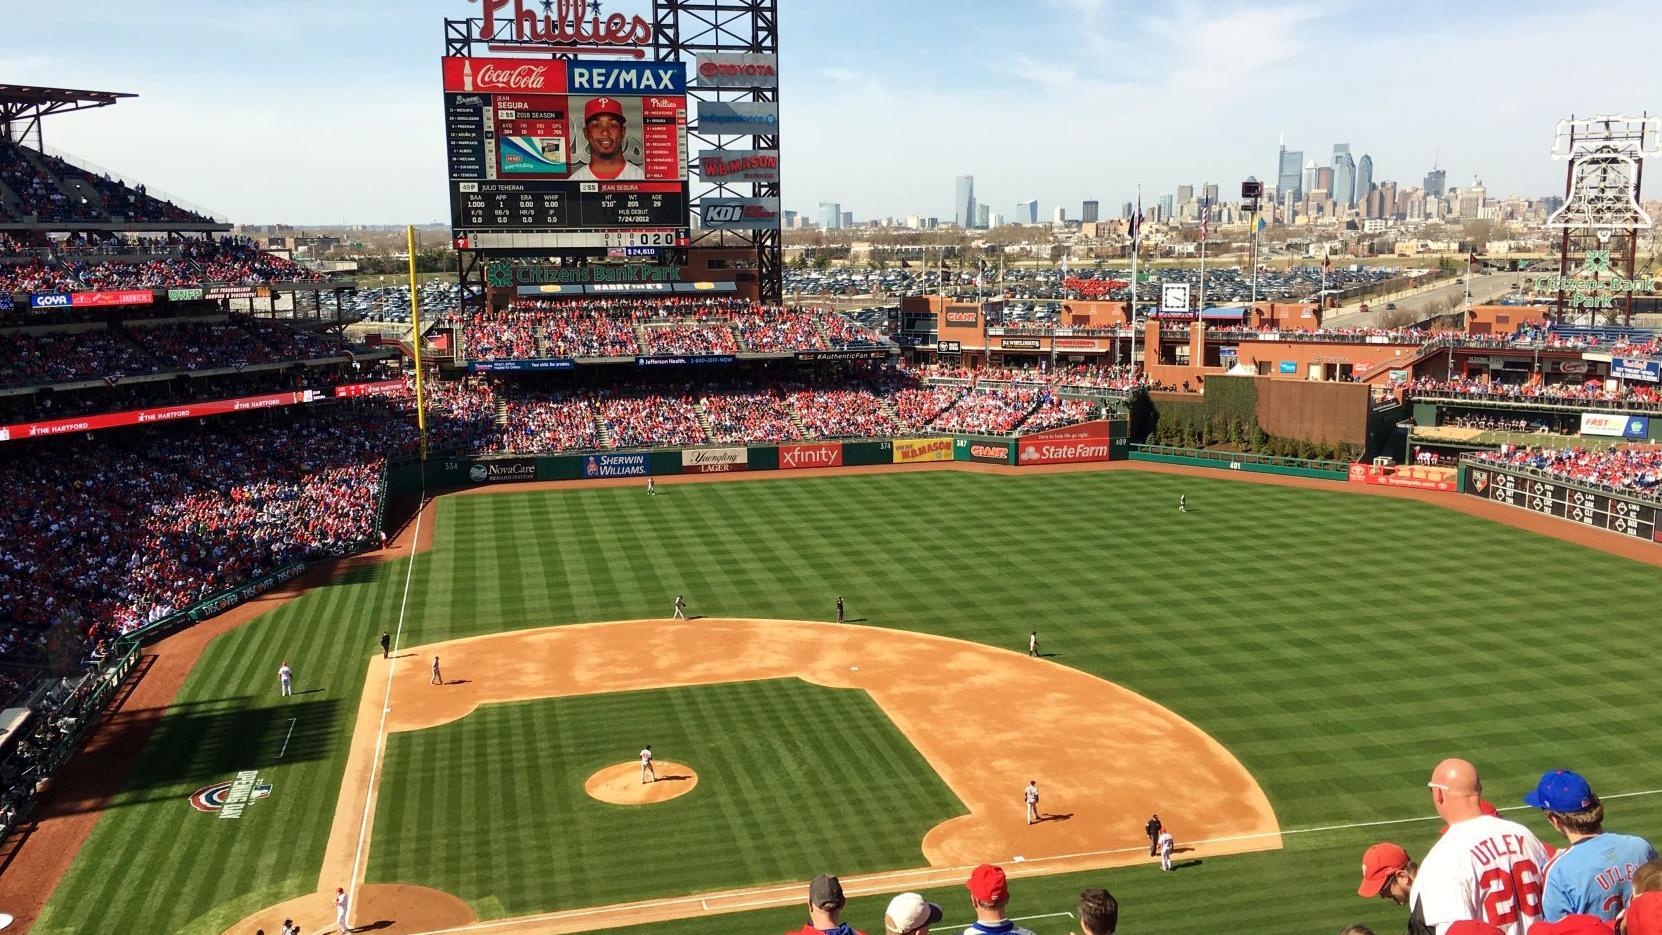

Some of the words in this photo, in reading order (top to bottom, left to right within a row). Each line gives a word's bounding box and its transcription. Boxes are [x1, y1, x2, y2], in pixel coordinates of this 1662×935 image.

[467, 0, 652, 47] Phillies
[719, 64, 775, 76] TOYOTA
[477, 64, 548, 90] Coca-Cola
[574, 68, 676, 91] RE/MAX
[651, 98, 677, 108] Phillies
[641, 234, 649, 245] 0
[653, 234, 661, 245] 2
[665, 233, 674, 244] 0
[517, 265, 591, 282] Citizens
[593, 264, 639, 282] Bank
[641, 264, 681, 281] Park
[1536, 276, 1606, 290] Citizens
[1610, 277, 1654, 291] Bank
[37, 295, 67, 306] GOYA
[180, 290, 202, 300] NFP
[1574, 294, 1613, 308] Park
[946, 312, 977, 322] GIANT
[252, 399, 280, 408] HARTFORD
[158, 410, 190, 420] HARTFORD
[1585, 418, 1608, 427] FAST
[37, 427, 49, 435] THE
[52, 423, 88, 433] HARTFORD
[880, 442, 891, 450] 374
[956, 440, 967, 448] 387
[691, 449, 739, 465] Yuengling
[783, 447, 838, 468] xfinity
[971, 446, 1008, 459] GIANT
[600, 455, 643, 466] SHERWIN
[1230, 462, 1241, 470] 401
[488, 464, 535, 475] NovaCare
[701, 463, 730, 472] LAGER
[1585, 510, 1593, 518] CLE
[242, 578, 273, 599] DISCOVER
[202, 594, 238, 616] DISCOVER
[1470, 834, 1524, 866] UTLEY
[1594, 863, 1640, 892] UTLE
[1480, 859, 1541, 927] 26
